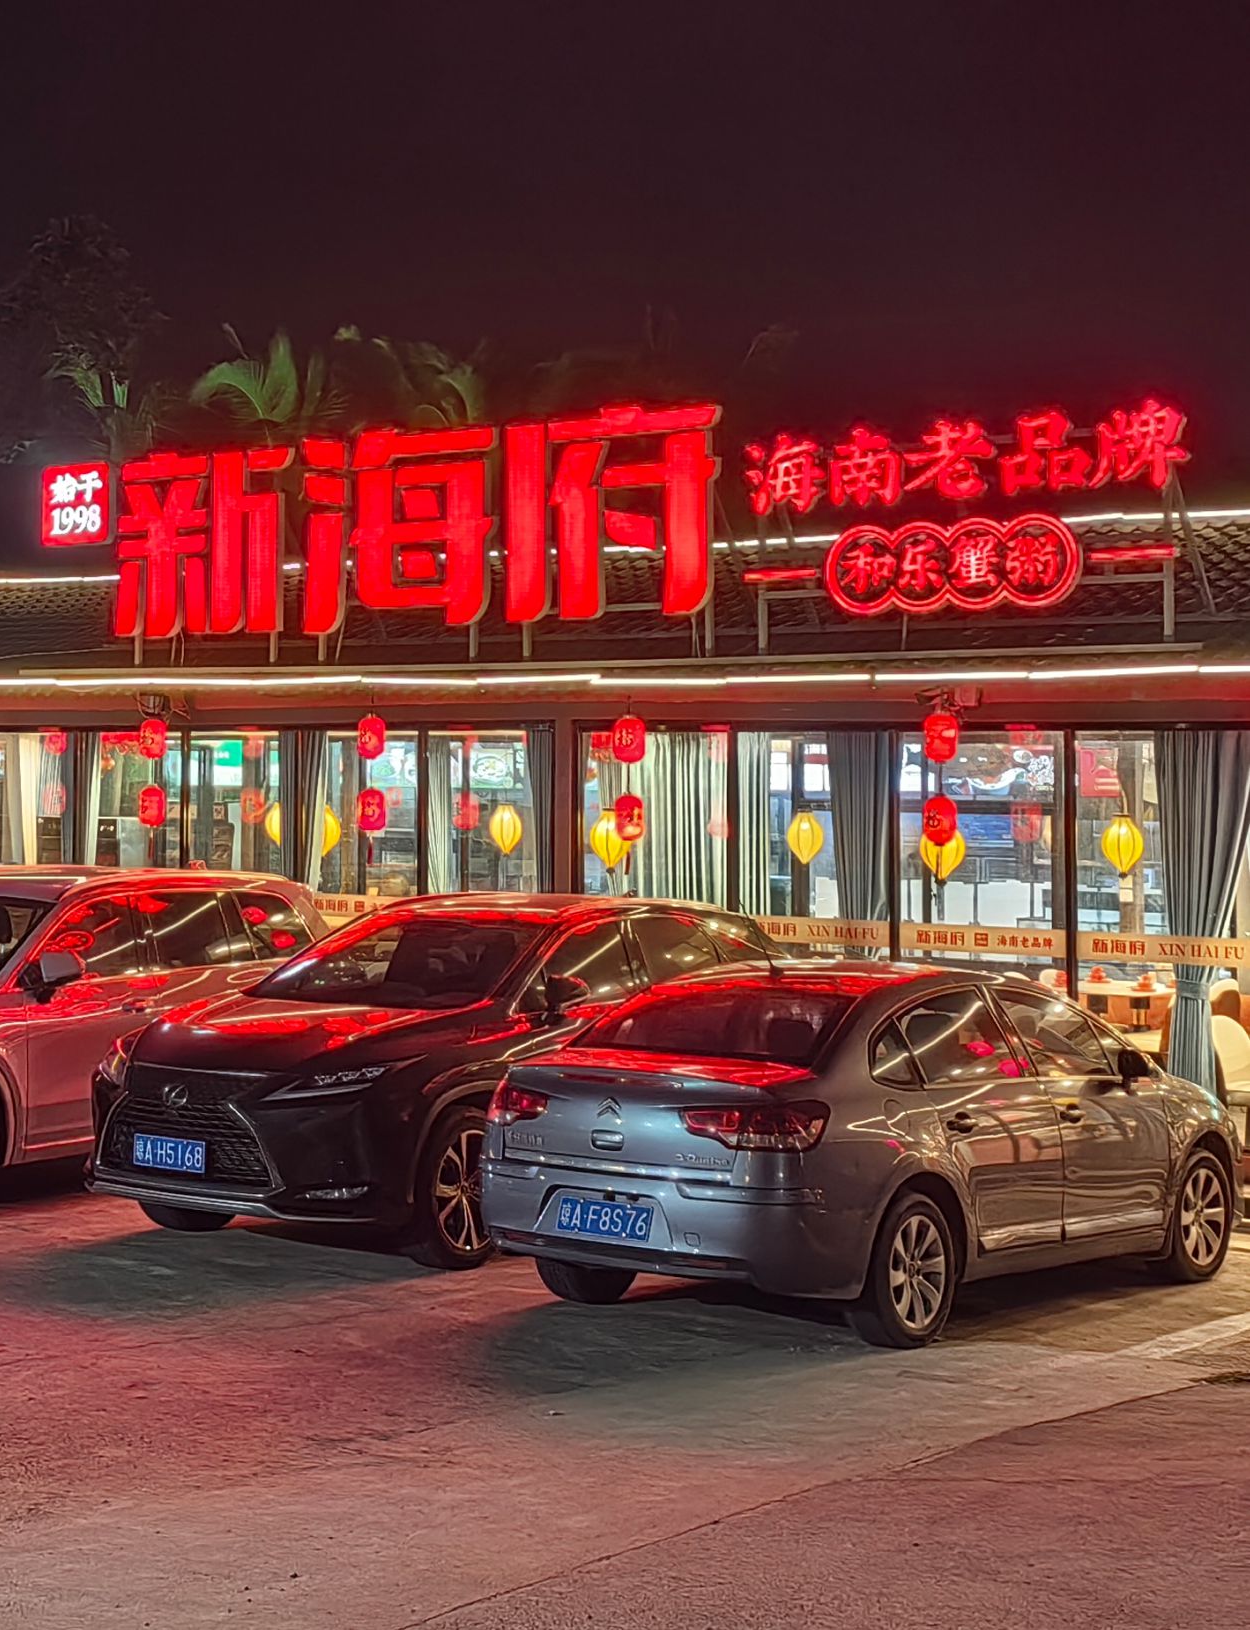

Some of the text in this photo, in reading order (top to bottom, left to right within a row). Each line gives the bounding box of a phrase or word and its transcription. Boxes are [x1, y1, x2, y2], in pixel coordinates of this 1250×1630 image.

[744, 399, 1190, 514] 海南老品牌
[50, 504, 102, 535] 1998
[114, 404, 721, 639] 新海府
[841, 535, 1060, 594] 和乐蟹粥
[807, 924, 830, 937] XIN
[834, 926, 859, 939] HAI
[862, 927, 879, 940] FU
[916, 930, 965, 946] 新海府
[997, 934, 1054, 949] 海南老品牌
[1092, 938, 1245, 960] 新海府 XIN HAI FU
